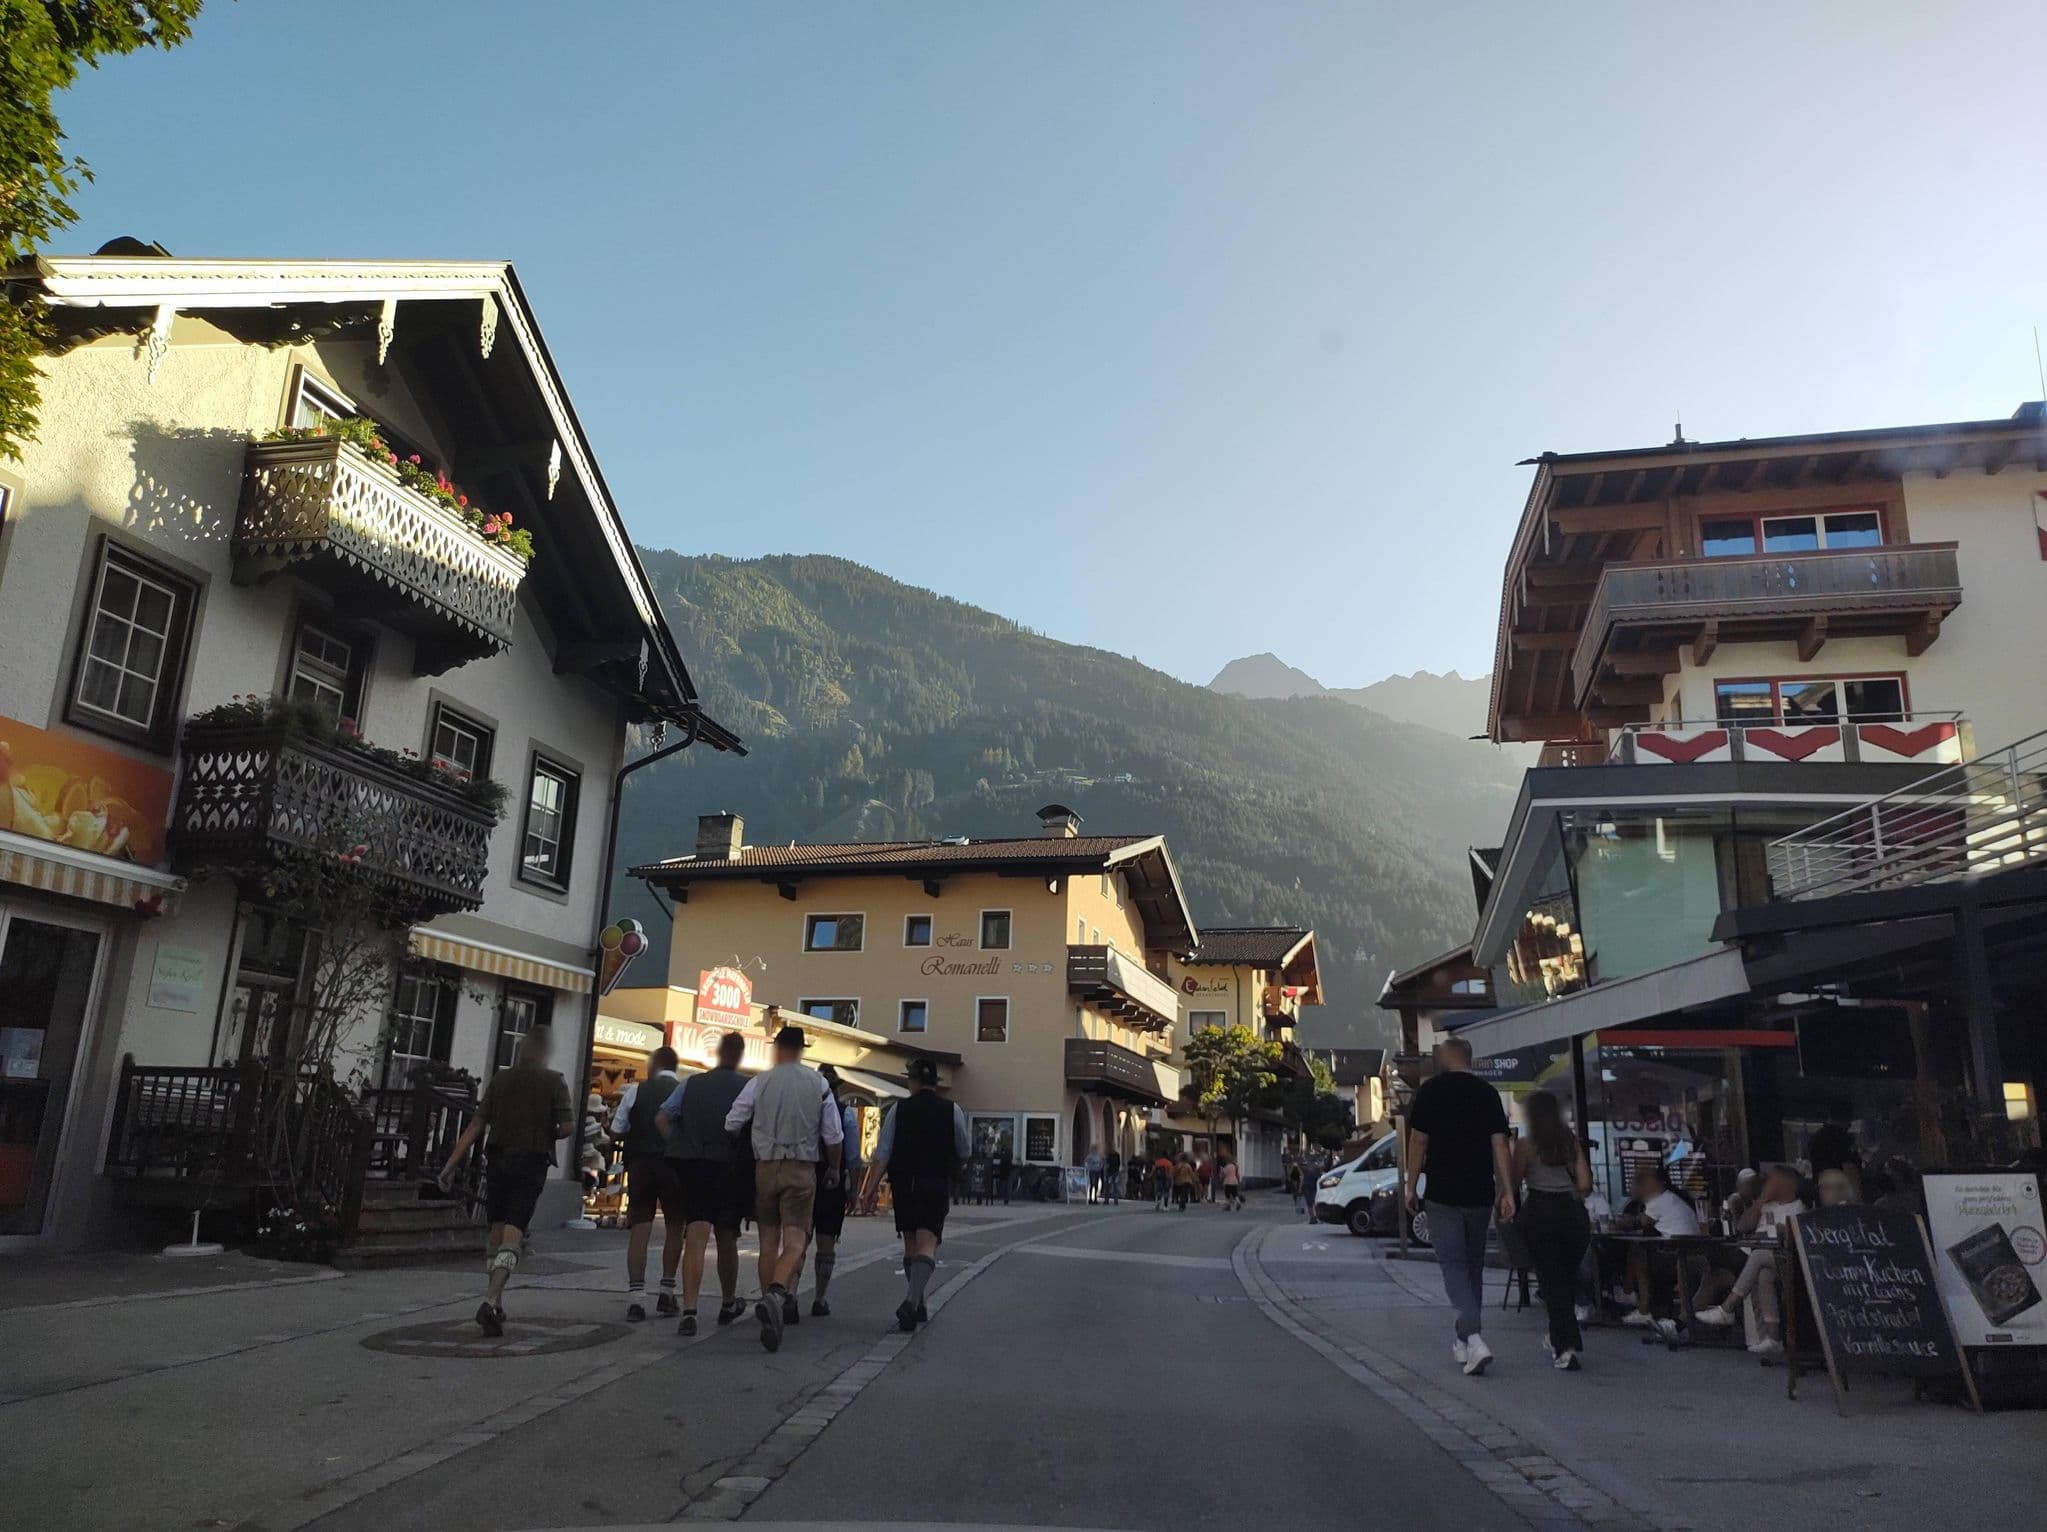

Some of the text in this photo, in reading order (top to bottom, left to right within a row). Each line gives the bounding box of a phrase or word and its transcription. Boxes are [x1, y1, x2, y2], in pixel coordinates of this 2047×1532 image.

[936, 932, 975, 947] Haus
[920, 956, 1000, 976] Romanelli
[712, 982, 741, 1009] 3000
[616, 1029, 647, 1047] mode
[1494, 1058, 1519, 1070] SHOP
[1842, 1281, 1870, 1298] mit
